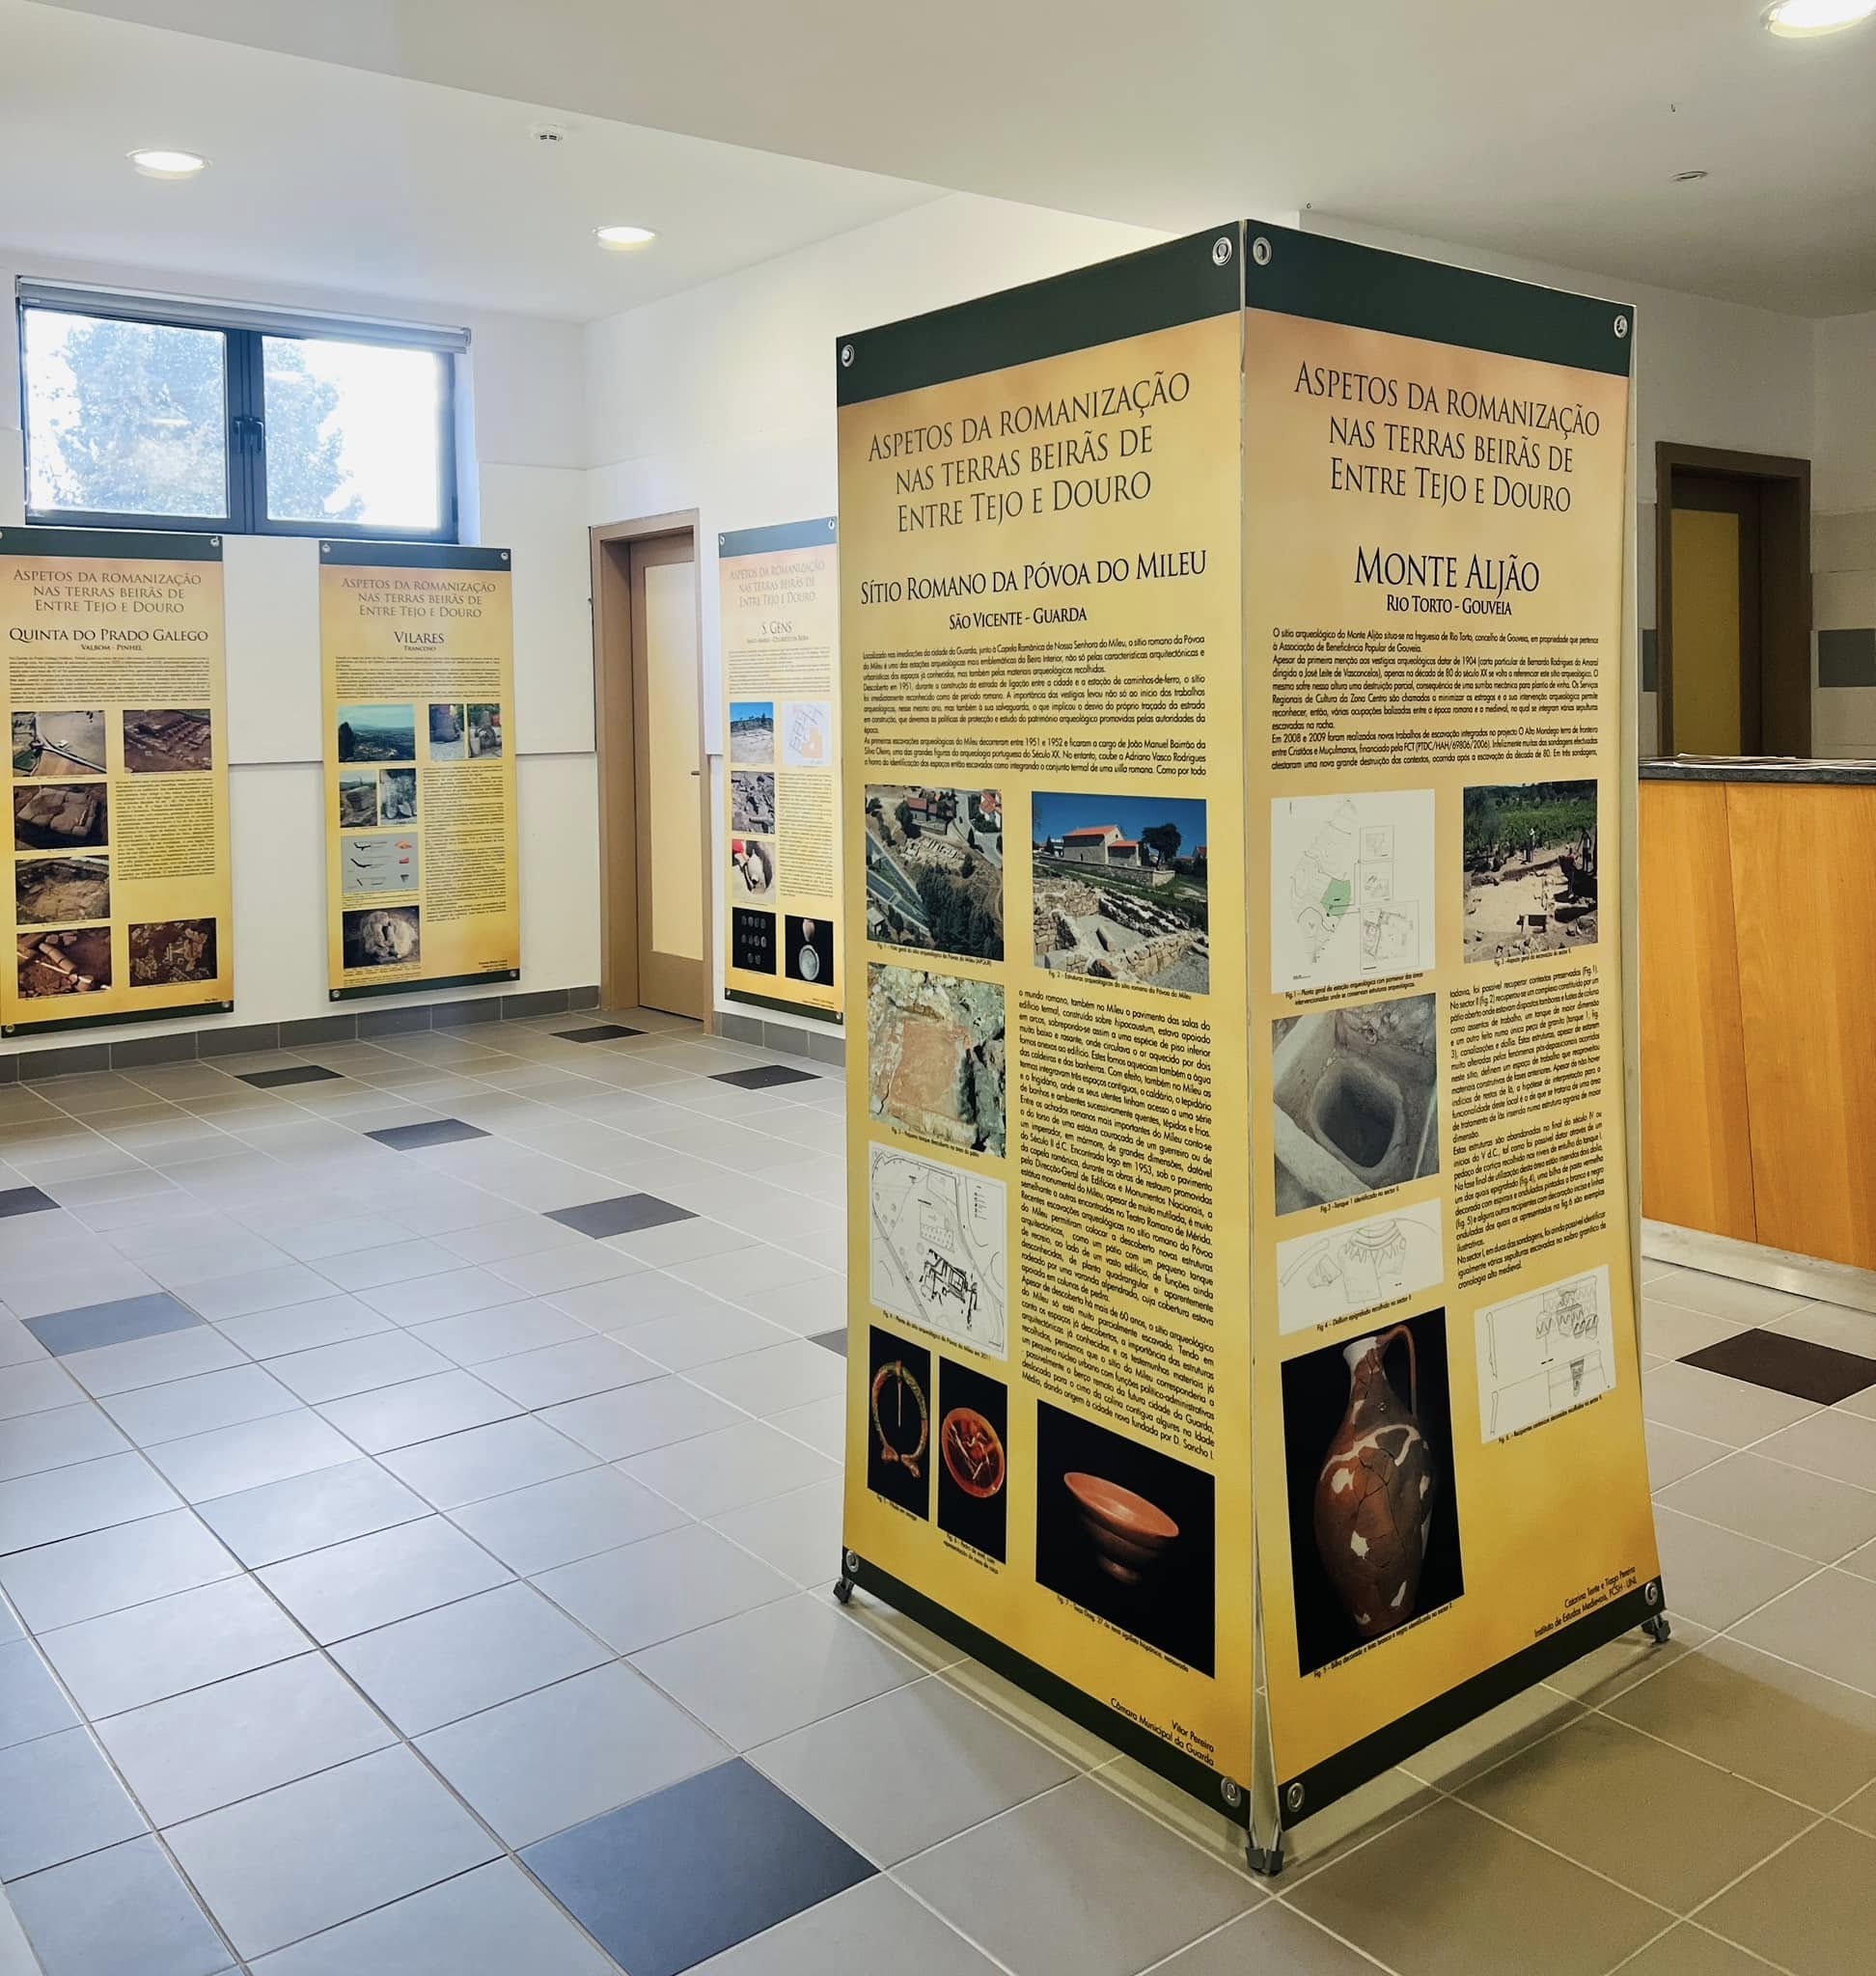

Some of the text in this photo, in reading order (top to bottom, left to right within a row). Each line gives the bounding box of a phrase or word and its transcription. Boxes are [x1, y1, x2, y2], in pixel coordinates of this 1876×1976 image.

[1294, 360, 1599, 440] ASPETOS DA ROMANIZAÇÃO
[869, 371, 1189, 462] ASPETOS DA ROMANIZAÇÃO
[896, 425, 1153, 494] NAS TERRAS BEIRÃS DE
[1329, 416, 1573, 473] NAS TERRAS BEIRÃS DE
[1331, 457, 1571, 512] ENTRE TEJO E DOURO
[898, 471, 1151, 532] ENTRE TEJO E DOURO
[13, 569, 201, 586] ASPETOS DA ROMANIZAÇÃO
[342, 579, 495, 594] ASPETOS DA ROMANIZAÇÃO
[861, 550, 1206, 604] SÍTIO ROMANO DA PÓVOA DO MILEU
[1355, 545, 1539, 598] MONTE ALJÃO
[34, 586, 184, 598] NAS TERRAS BEIRÃS DE
[36, 600, 184, 613] ENTRE TEJO E DOURO
[358, 593, 482, 604] NAS TERRAS BEIRÃS DE
[1387, 595, 1409, 612] RIO
[1411, 596, 1452, 613] TORTO
[1462, 598, 1512, 615] GOUVEIA
[359, 605, 396, 616] ENTRE
[401, 606, 425, 618] TEJO
[440, 607, 482, 617] DOURO
[770, 621, 792, 634] GENS
[949, 613, 971, 630] SÃO
[974, 611, 1022, 628] VICENTE
[1033, 607, 1087, 624] GUARDA
[9, 628, 208, 643] QUINTA DO PRADO GALEGO
[394, 632, 444, 643] VILARES
[1279, 643, 1314, 653] Associação
[1326, 644, 1363, 652] Beneficência
[1365, 645, 1386, 653] Popular
[1025, 991, 1043, 1000] mundo
[1045, 995, 1068, 1005] romano,
[1071, 998, 1094, 1010] também
[1107, 1004, 1124, 1015] Mileu
[1133, 1010, 1165, 1023] pavimento
[1167, 1015, 1179, 1025] das
[1182, 1018, 1198, 1029] salas
[1201, 1021, 1210, 1031] do
[1020, 1095, 1034, 1106] Entre
[1044, 1102, 1068, 1114] achados
[1070, 1109, 1095, 1121] romanos
[1098, 1116, 1112, 1125] mais
[1114, 1119, 1150, 1135] importantes
[1152, 1128, 1161, 1138] do
[1164, 1132, 1182, 1144] Mileu
[1021, 1190, 1044, 1205] Recentes
[1047, 1198, 1079, 1216] escavações
[1127, 1225, 1135, 1234] no
[1152, 1234, 1178, 1248] romano
[1180, 1240, 1189, 1251] da
[1192, 1244, 1212, 1258] Póvoa
[1458, 1275, 1486, 1289] cronologia
[1044, 1380, 1062, 1394] dando
[1064, 1390, 1084, 1402] origem
[1092, 1401, 1113, 1416] cidade
[1115, 1412, 1130, 1423] nova
[1131, 1417, 1159, 1435] fundada
[1160, 1431, 1172, 1442] por
[1173, 1435, 1180, 1445] D.
[1183, 1439, 1208, 1457] Sancho
[1555, 1616, 1561, 1626] de
[1562, 1609, 1581, 1622] Estudos
[1609, 1585, 1622, 1597] FCSH
[1564, 1595, 1586, 1608] Catarina
[1587, 1585, 1600, 1596] Tente
[1605, 1576, 1618, 1586] Tiago
[1111, 1698, 1214, 1766] Câmara Municipal da Guarda
[1190, 1731, 1214, 1752] Pereira
